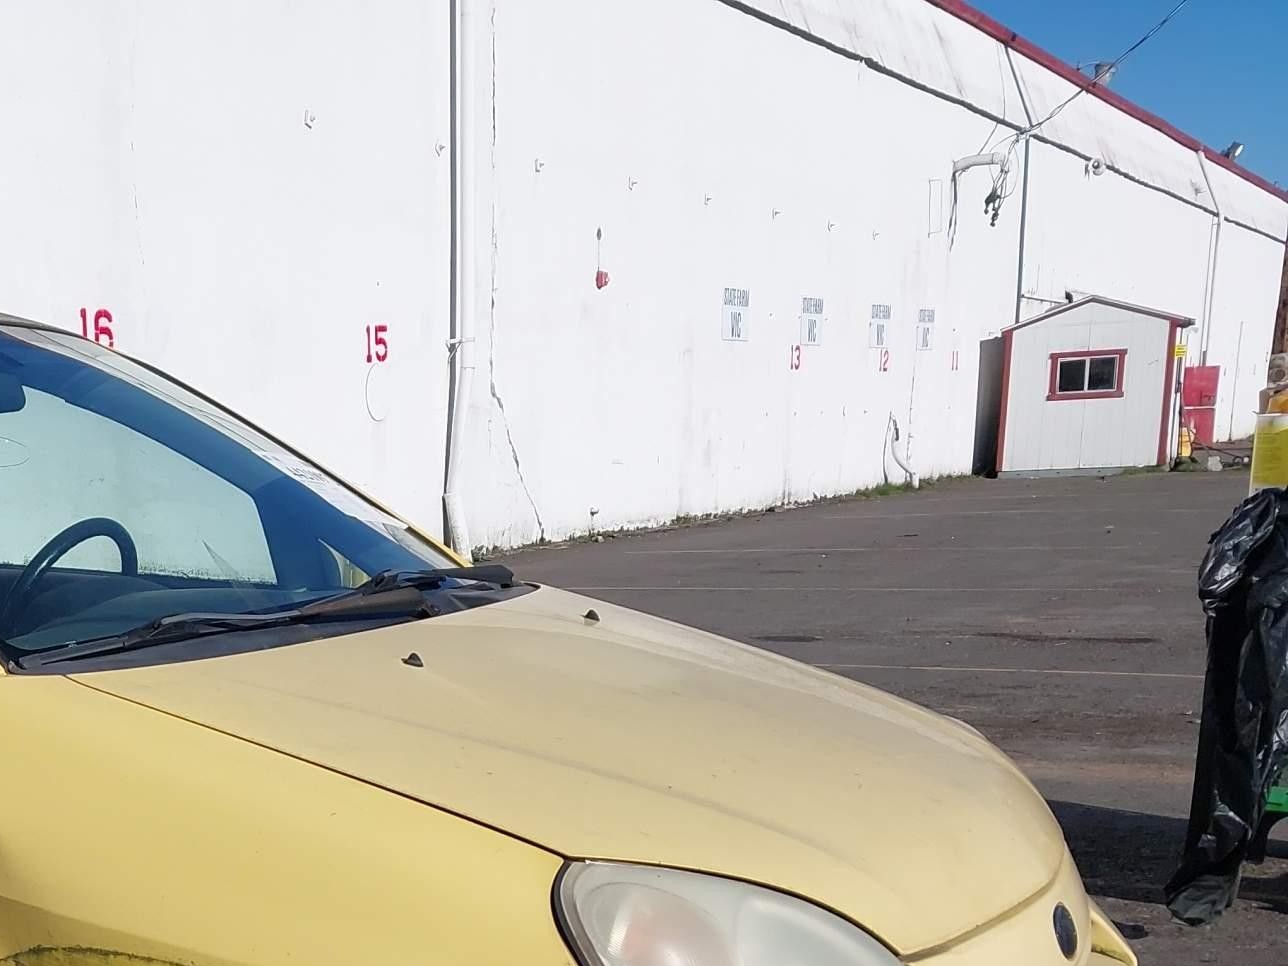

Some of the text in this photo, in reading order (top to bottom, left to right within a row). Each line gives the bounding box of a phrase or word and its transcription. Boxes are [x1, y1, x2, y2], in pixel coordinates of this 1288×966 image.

[79, 308, 114, 350] 16
[366, 325, 388, 363] 15
[790, 345, 801, 370] 13
[879, 350, 889, 372] 12
[951, 351, 959, 371] 11
